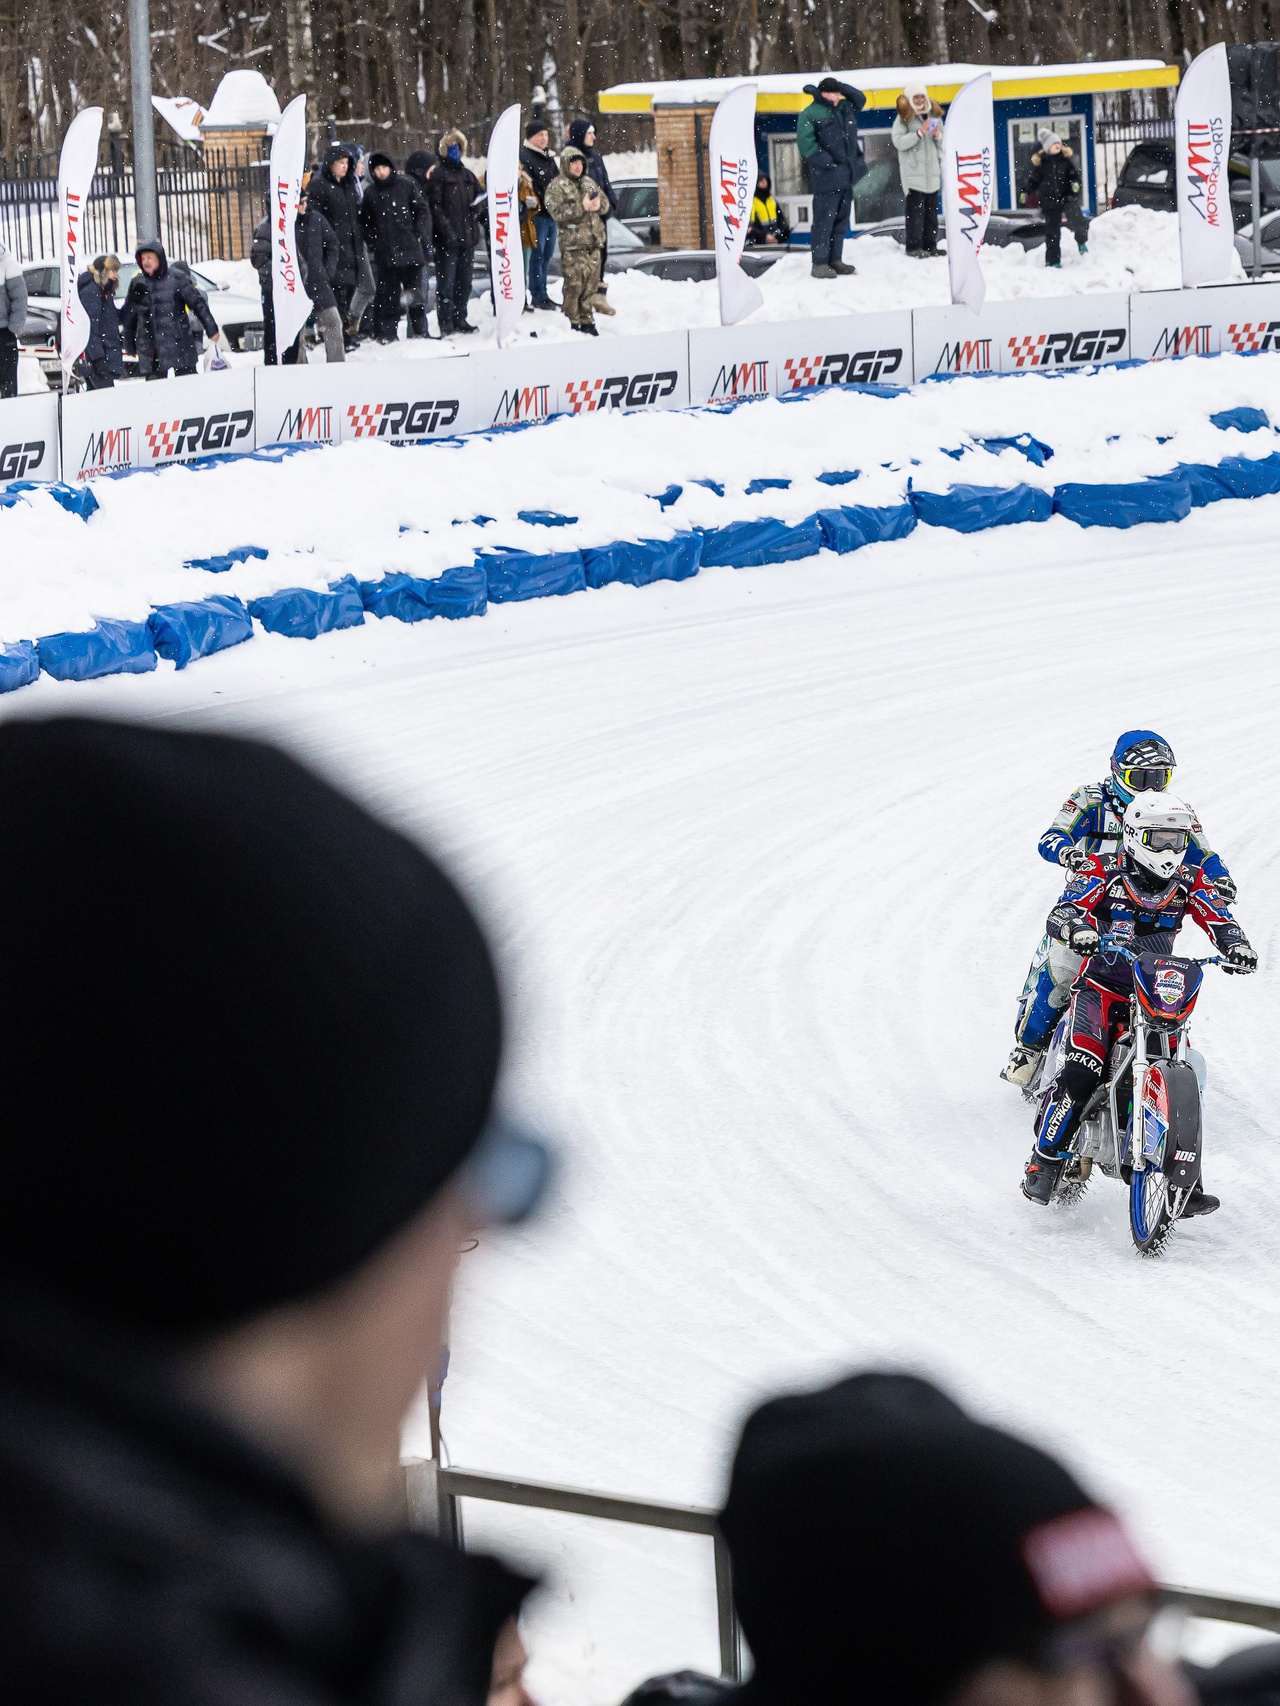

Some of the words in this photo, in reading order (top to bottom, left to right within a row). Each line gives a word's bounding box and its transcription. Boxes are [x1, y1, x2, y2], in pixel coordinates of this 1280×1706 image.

[1207, 117, 1223, 226] MOTORSPORTS
[1041, 328, 1126, 365] RGP
[817, 348, 903, 385] RGP
[597, 370, 678, 411] RGP
[174, 409, 254, 455] RGP
[377, 399, 460, 436] RGP
[1066, 1052, 1103, 1077] DEKRA
[1045, 1092, 1073, 1143] KOLTAKOV
[1174, 1149, 1197, 1162] 106
